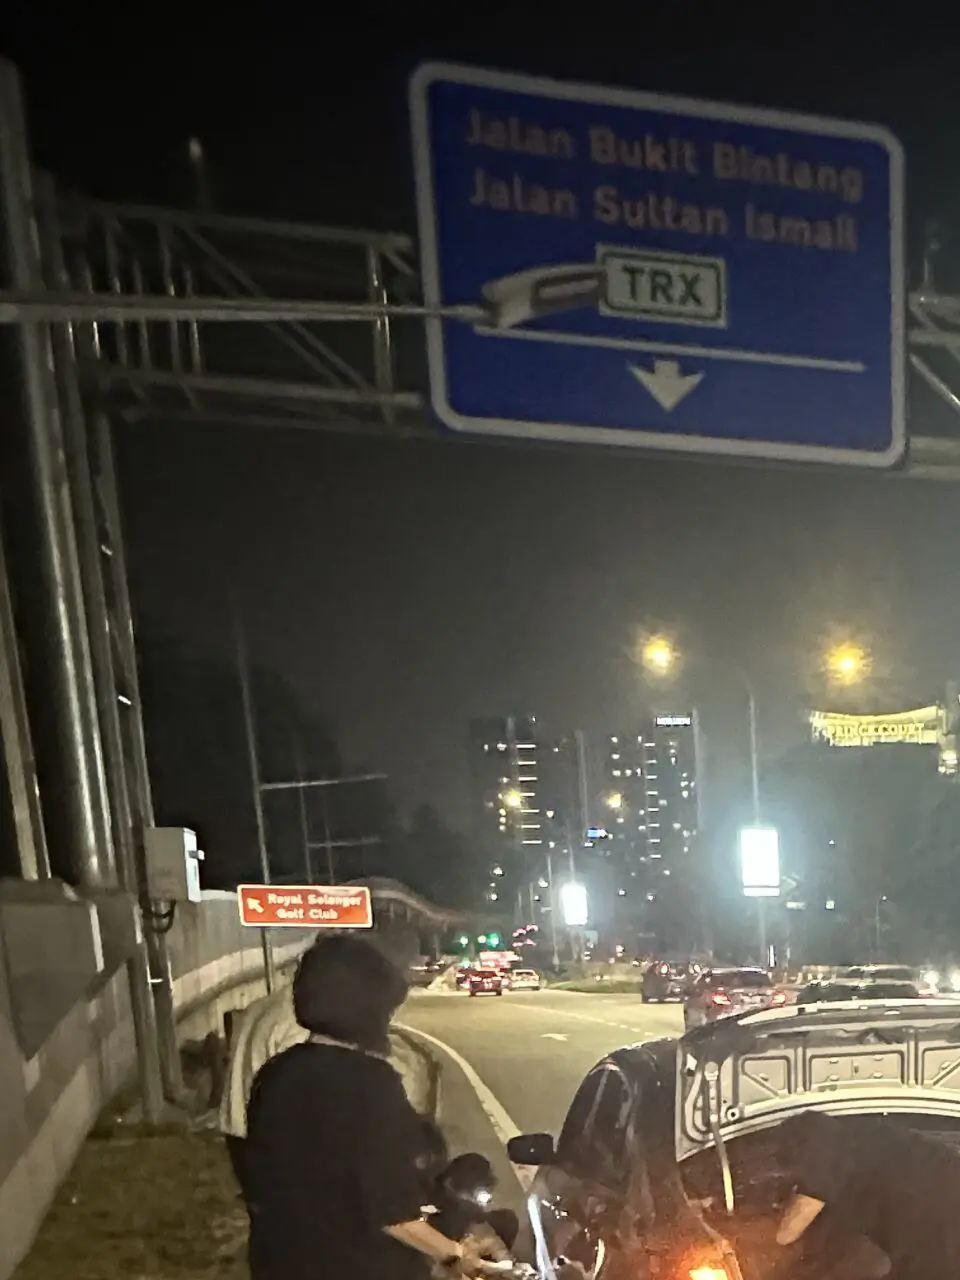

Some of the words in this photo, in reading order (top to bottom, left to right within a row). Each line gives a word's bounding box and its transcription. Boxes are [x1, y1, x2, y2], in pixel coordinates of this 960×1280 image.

[467, 107, 574, 159] Jalan
[589, 123, 698, 174] Bukit
[713, 141, 863, 203] Bintang
[469, 167, 578, 219] Jalan
[594, 185, 728, 236] Sultan
[745, 202, 857, 252] Ismail
[621, 264, 704, 306] TRX
[267, 893, 303, 906] Royal
[276, 908, 304, 919] Golf
[309, 908, 338, 920] Club
